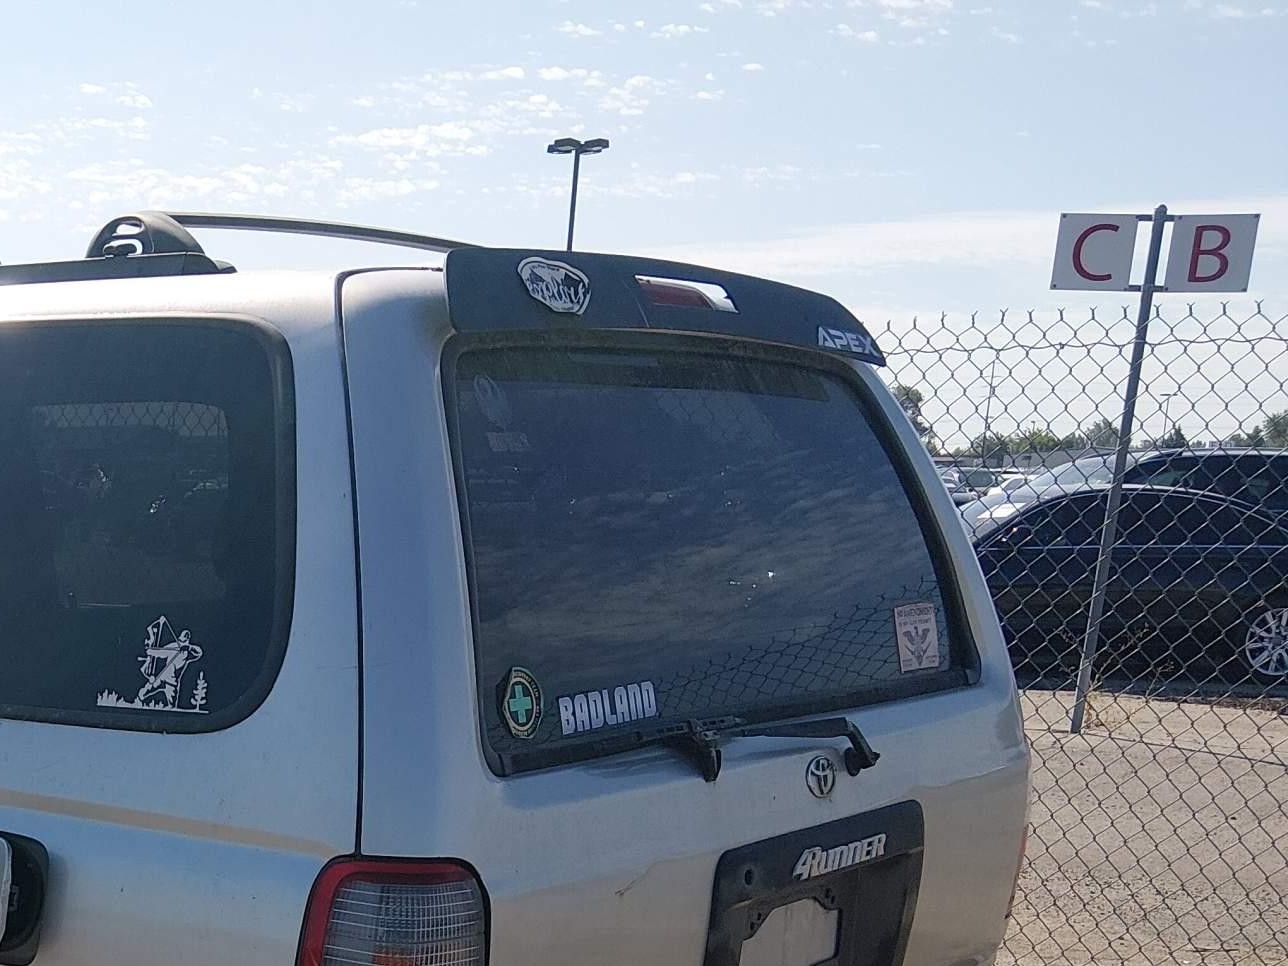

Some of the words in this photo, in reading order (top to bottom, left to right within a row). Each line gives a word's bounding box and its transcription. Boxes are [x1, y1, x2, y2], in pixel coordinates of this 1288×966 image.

[1072, 223, 1120, 282] C
[1187, 224, 1232, 283] B
[818, 326, 882, 357] APEX
[558, 680, 657, 735] BADLAND
